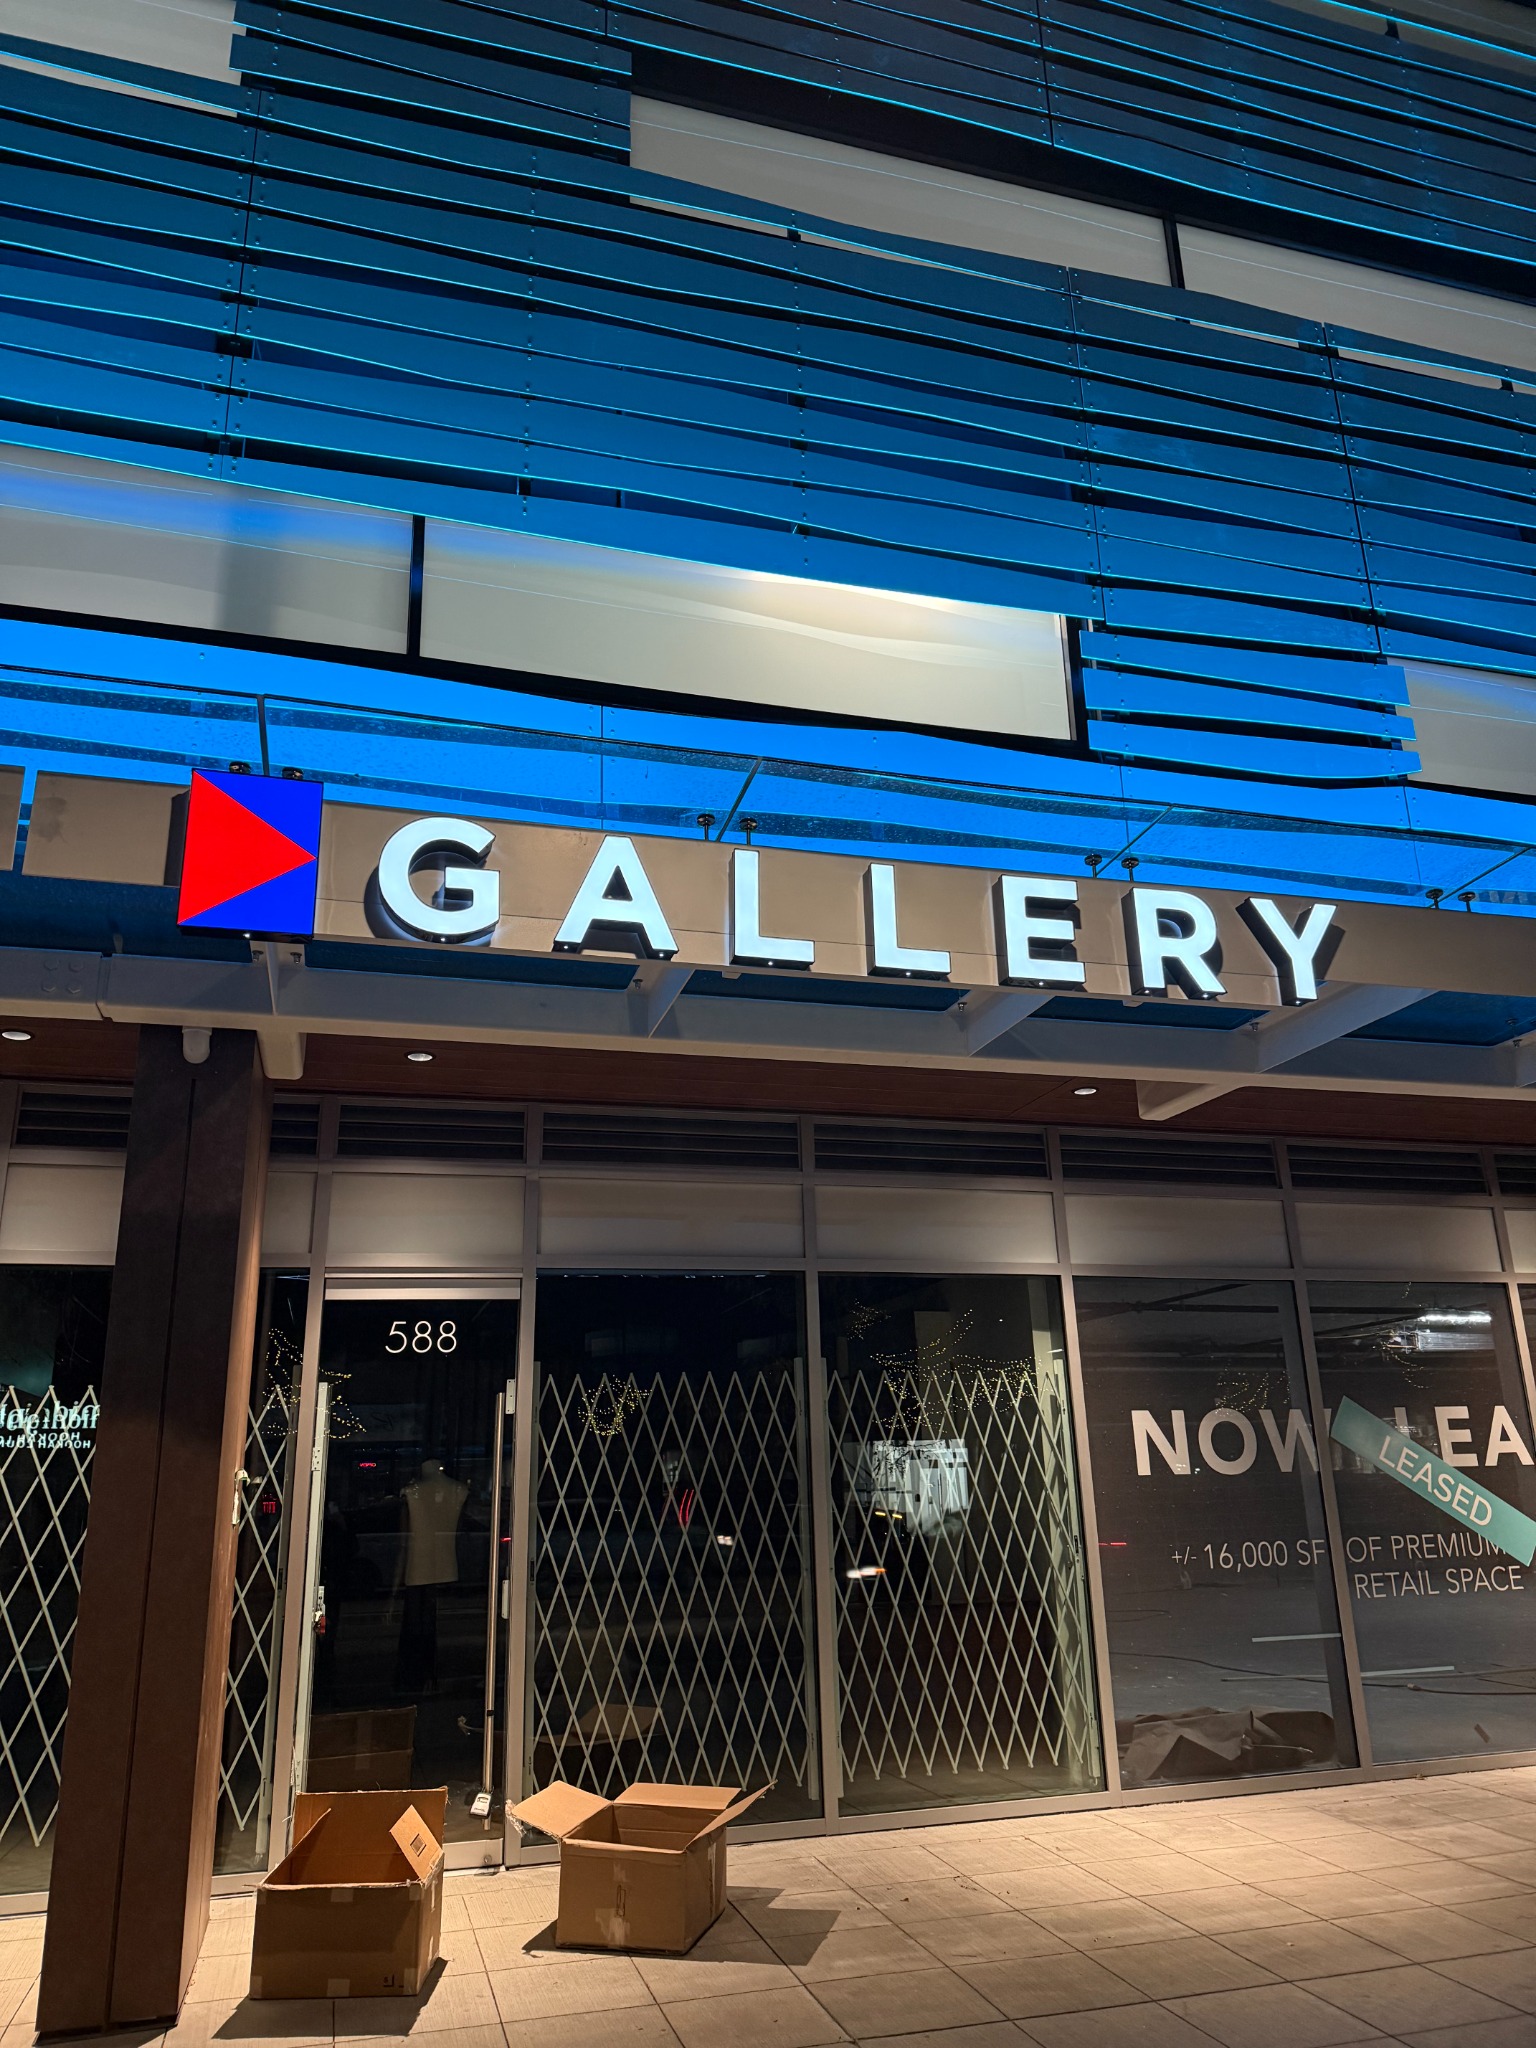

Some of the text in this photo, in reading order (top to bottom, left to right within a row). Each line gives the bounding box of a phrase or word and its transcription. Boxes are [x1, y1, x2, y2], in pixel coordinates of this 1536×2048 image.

[375, 815, 1338, 1005] GALLERY
[385, 1320, 457, 1354] 588
[1131, 1407, 1332, 1476] NOW
[1378, 1435, 1493, 1526] LEASED
[1171, 1546, 1197, 1565] +/-
[1204, 1541, 1288, 1573] 16,000
[1296, 1539, 1325, 1566] SF
[1346, 1536, 1382, 1562] OF
[1354, 1566, 1524, 1599] RETAIL SPACE
